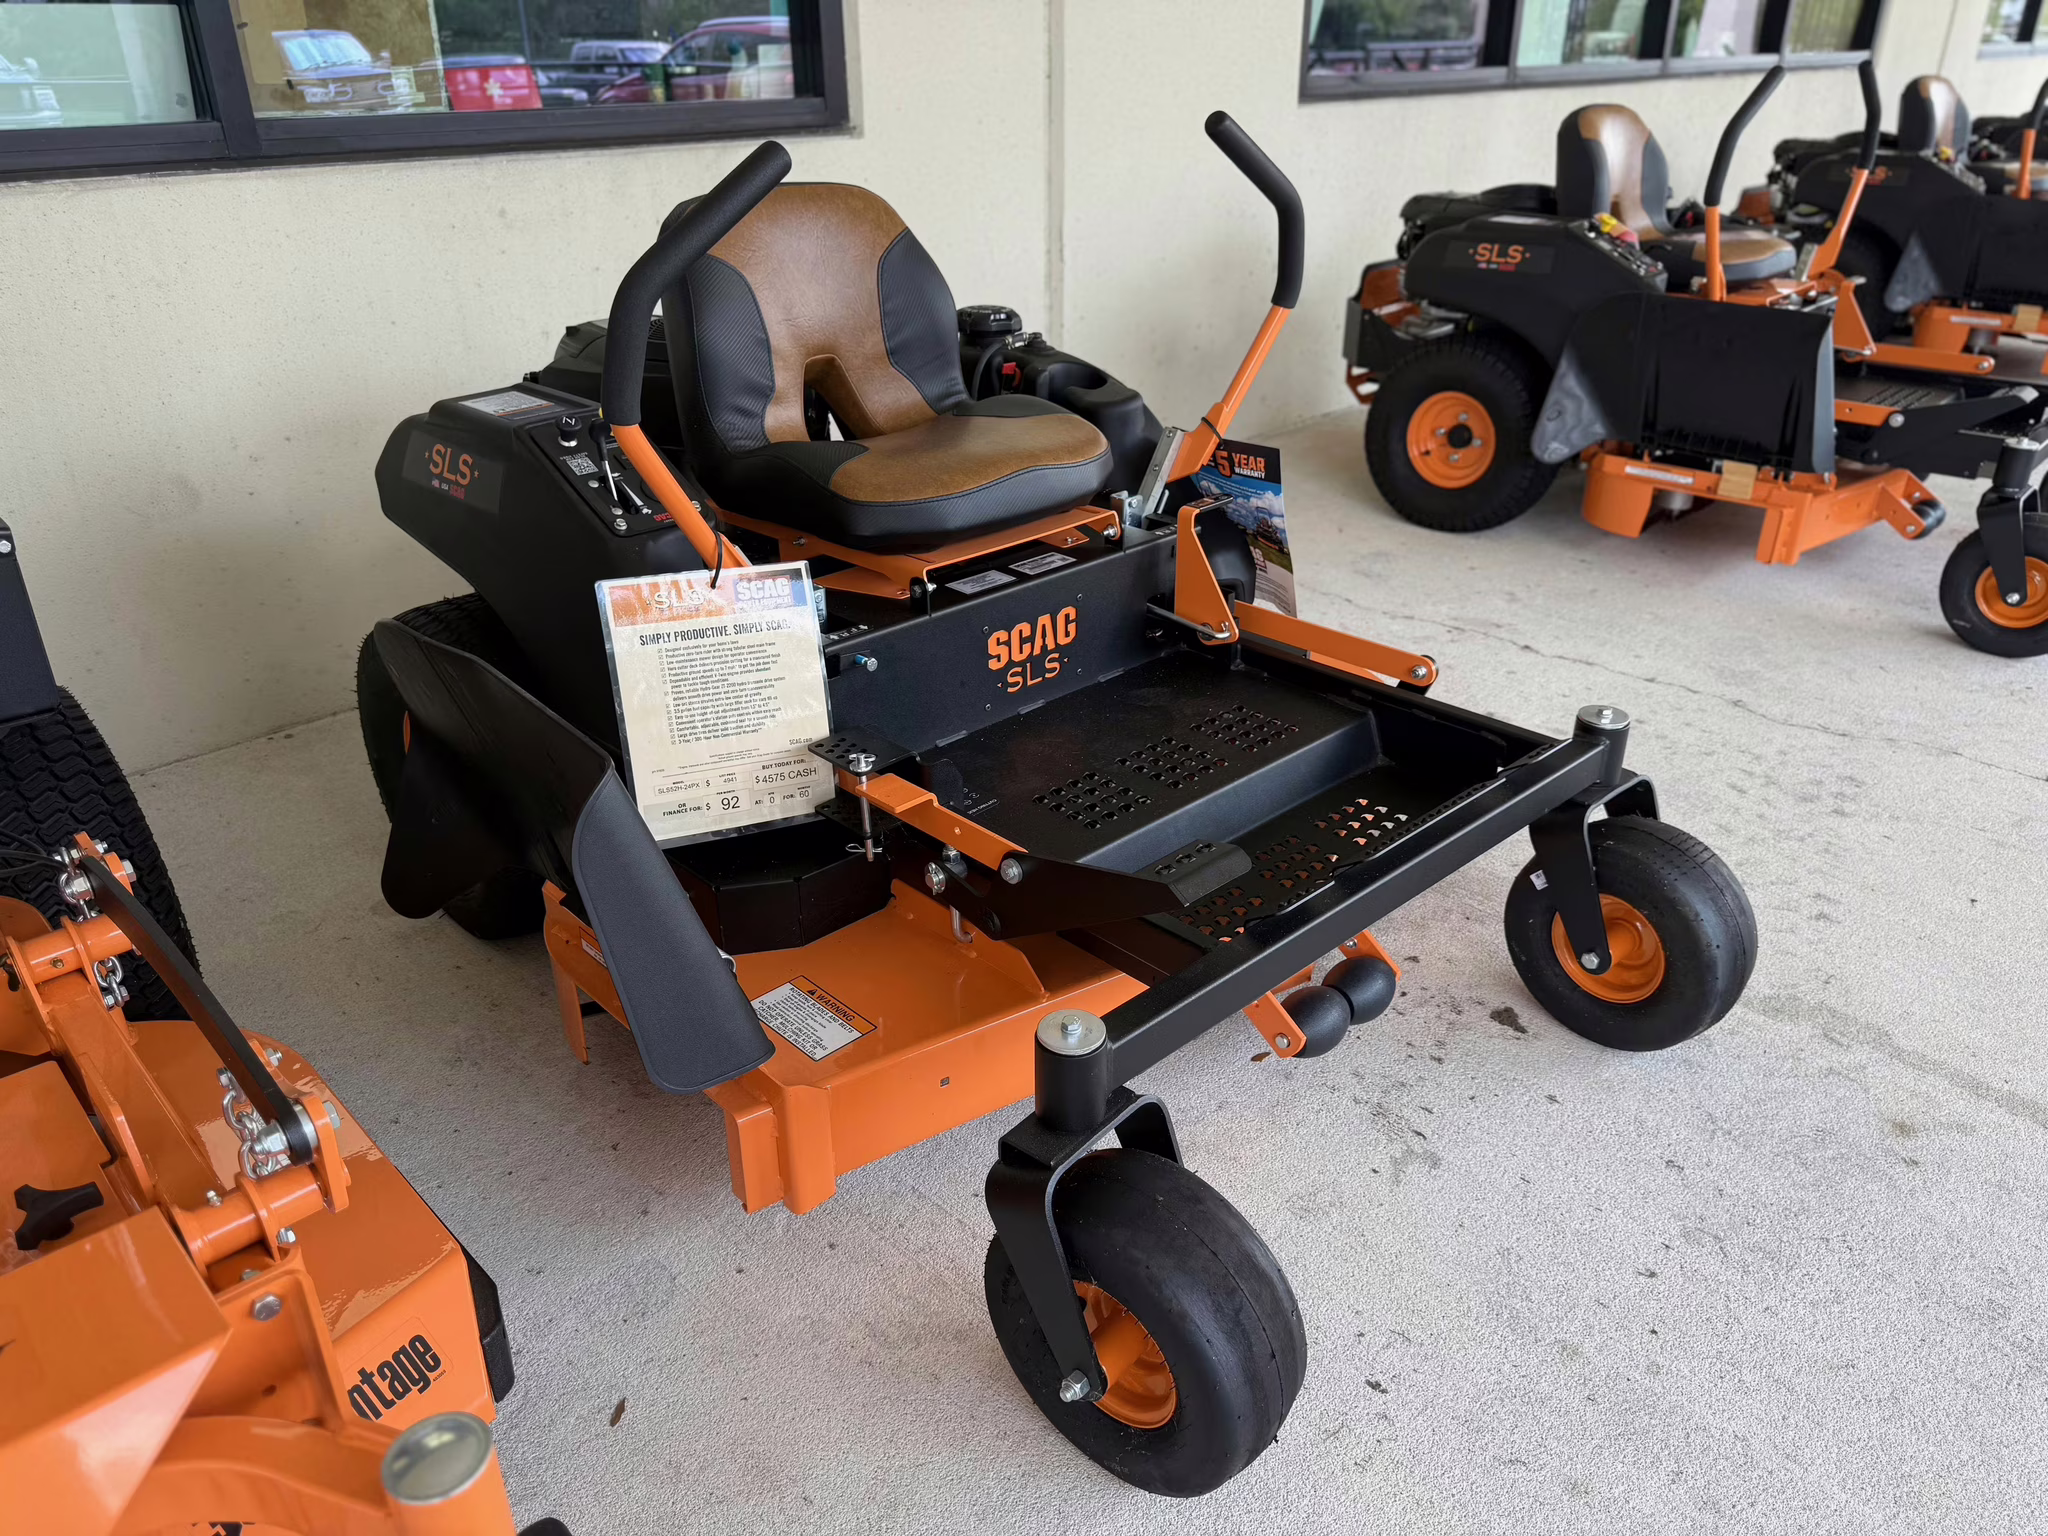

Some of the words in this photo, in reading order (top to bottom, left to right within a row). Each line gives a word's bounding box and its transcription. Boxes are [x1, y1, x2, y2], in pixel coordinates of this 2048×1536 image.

[1475, 243, 1524, 264] SLS
[429, 444, 473, 485] SLS
[1215, 449, 1232, 478] 5
[1231, 452, 1265, 474] YEAR
[1233, 466, 1266, 479] WARRANTY
[736, 578, 790, 600] SCAG
[639, 632, 671, 645] SIMPLY
[674, 625, 731, 641] PRODUCTIVE.
[733, 622, 763, 635] SIMPLY
[766, 619, 790, 631] SCAG.
[987, 605, 1077, 671] SCAG
[1006, 653, 1061, 693] SLS
[658, 782, 700, 794] SLS52H-24PX
[755, 775, 760, 784] $
[761, 772, 786, 784] 4575
[788, 767, 817, 779] CASH
[706, 803, 711, 811] $
[721, 796, 740, 811] 92
[799, 790, 810, 798] 60
[789, 988, 811, 1003] ROTATING
[810, 1003, 828, 1015] BLADES
[828, 1015, 839, 1023] AND
[838, 1023, 853, 1033] BELTS
[815, 994, 856, 1022] WARNING
[775, 1012, 795, 1026] OPERATE
[794, 1026, 812, 1039] UNLESS
[811, 1039, 828, 1051] GRASS
